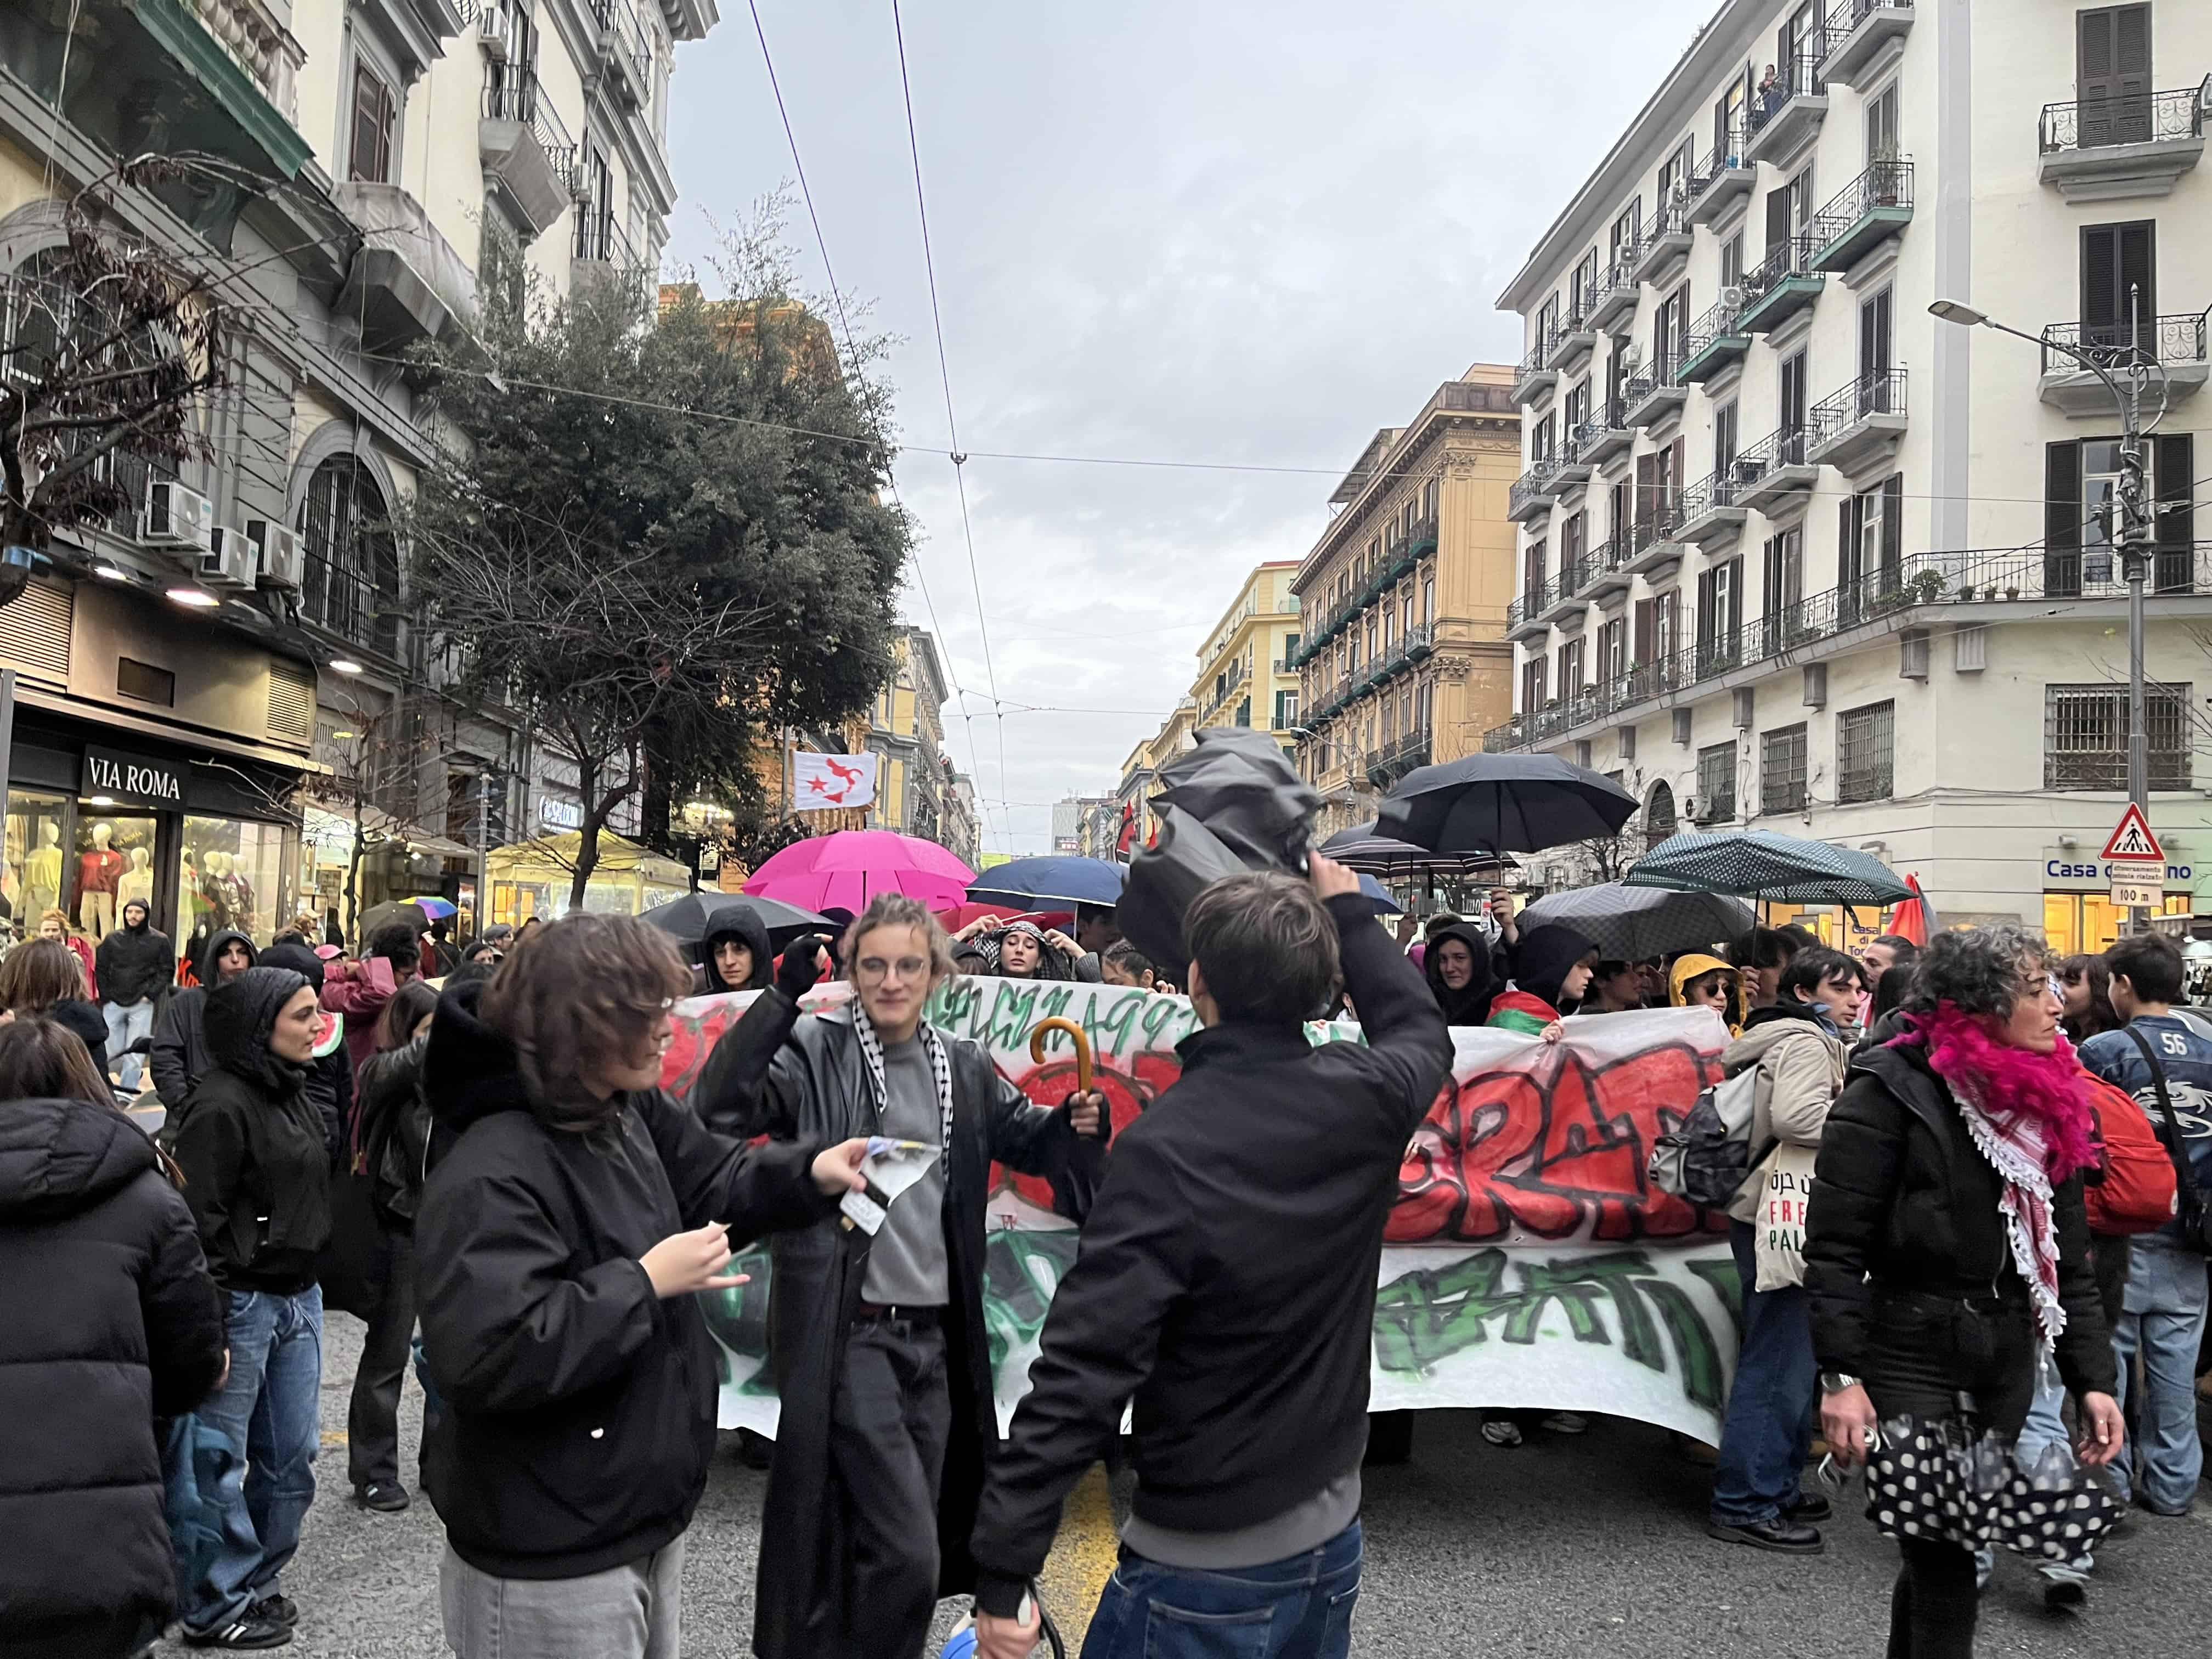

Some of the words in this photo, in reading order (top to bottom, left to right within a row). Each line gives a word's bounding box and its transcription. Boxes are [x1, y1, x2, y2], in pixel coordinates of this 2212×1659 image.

[89, 757, 121, 789] VIA
[126, 765, 180, 800] ROMA
[2047, 860, 2097, 877] Casa
[2120, 889, 2136, 901] 100
[1859, 936, 1869, 944] di
[2160, 1032, 2188, 1056] 56
[1770, 1200, 1805, 1226] FRE
